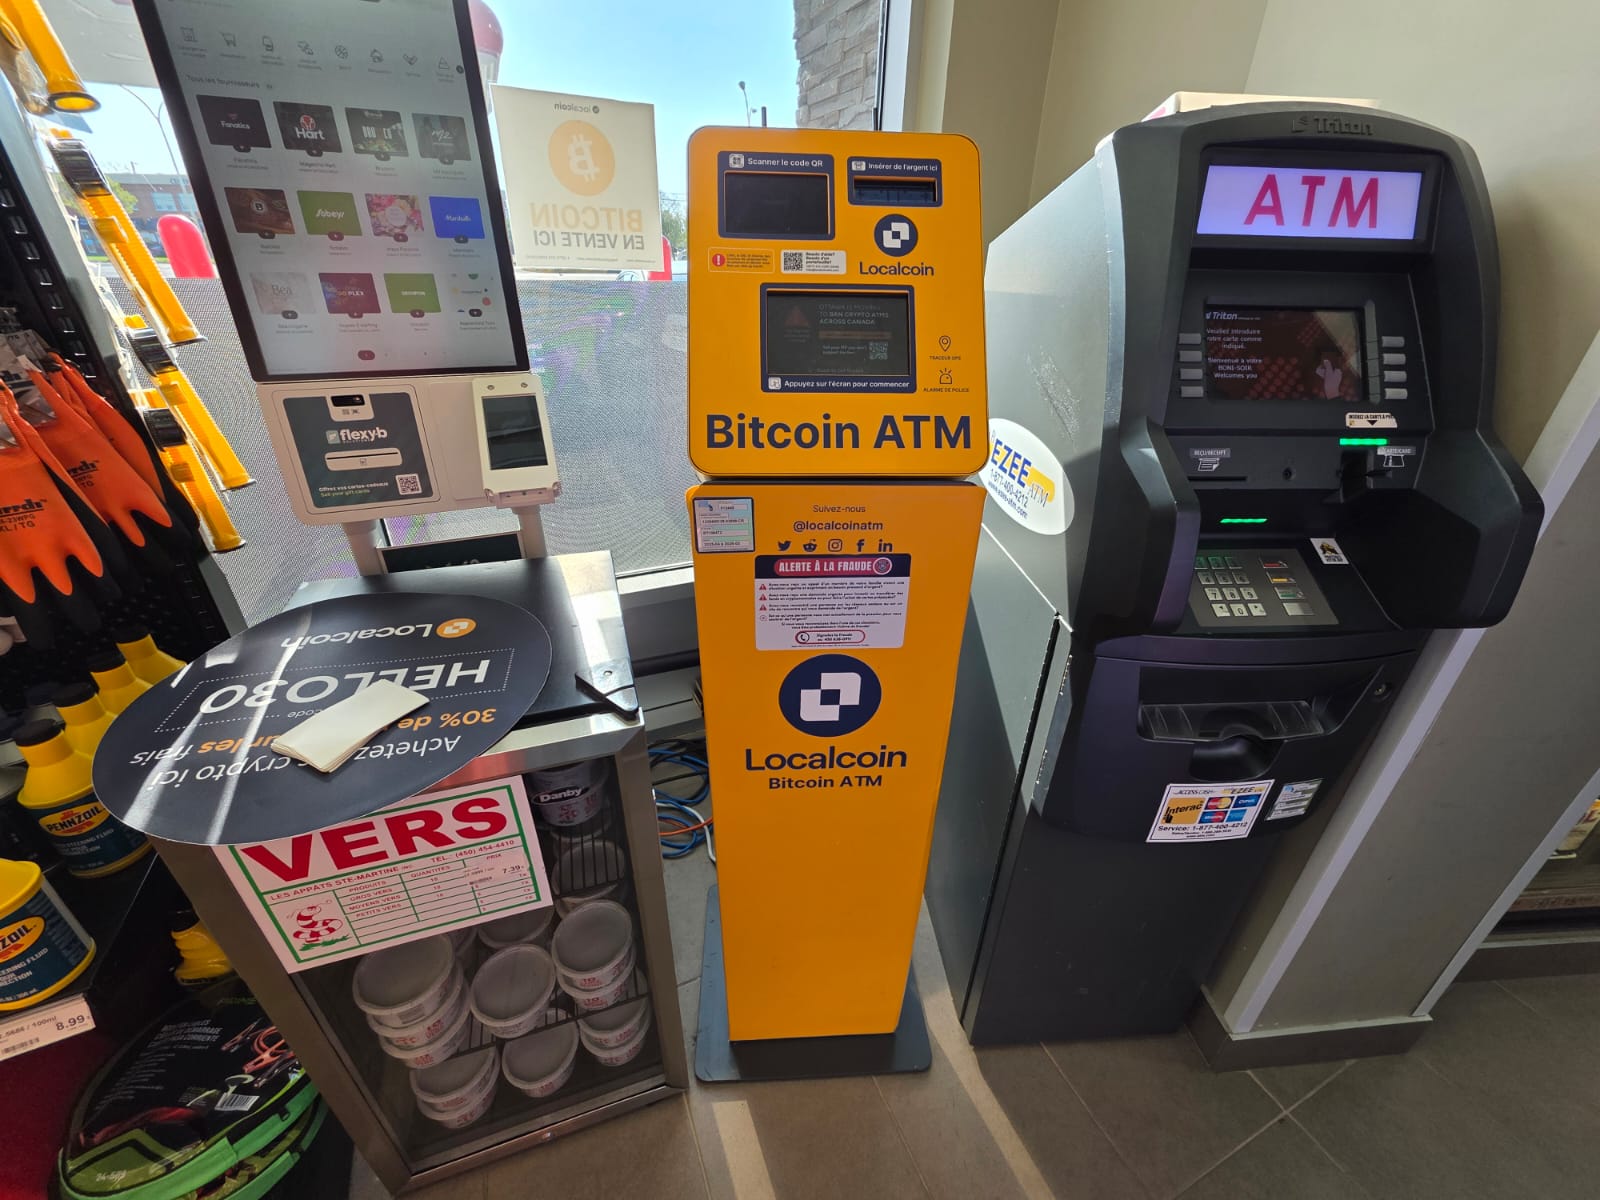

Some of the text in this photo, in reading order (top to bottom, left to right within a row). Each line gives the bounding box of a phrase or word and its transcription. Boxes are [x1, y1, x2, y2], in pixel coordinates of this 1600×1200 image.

[296, 126, 325, 140] Hart
[1314, 117, 1374, 136] Triton
[748, 158, 824, 168] Scanner le code QR
[894, 162, 902, 170] de
[1244, 174, 1379, 228] ATM
[860, 260, 934, 276] Localcoin
[1212, 312, 1238, 320] Triton
[784, 380, 814, 389] Appuyez
[828, 380, 851, 388] l'écran
[852, 381, 868, 389] pour
[870, 380, 910, 388] commencer
[706, 413, 971, 449] Bitcoin ATM
[990, 438, 1032, 488] EZEE
[1029, 483, 1049, 508] ATM
[813, 504, 866, 513] Suivez-nous
[18, 520, 36, 528] TG
[793, 520, 883, 533] @localcoinatm
[779, 559, 872, 572] ALERTE À LA FRAUDE
[280, 623, 433, 650] Localcoin
[200, 660, 490, 714] HELLO30
[129, 708, 496, 766] 30% de ur les frais
[148, 735, 460, 791] Achetez crypto ici
[745, 745, 907, 770] Localcoin
[768, 775, 882, 790] Bitcoin ATM
[540, 788, 582, 802] Danby
[1164, 804, 1202, 816] Interac
[46, 806, 102, 832] PENNZOIL
[1192, 822, 1248, 830] 1-877-400-4212
[240, 798, 508, 882] VERS
[270, 892, 290, 900] LES
[456, 850, 476, 858] (450)
[478, 840, 514, 852] 454-4410
[503, 864, 520, 874] 7.39
[348, 880, 387, 892] PRODUITS
[348, 900, 380, 911] MOYENS
[382, 894, 400, 903] VERS
[350, 888, 392, 902] GROS VERS
[356, 906, 382, 918] PETITS
[382, 903, 402, 912] VERS
[26, 948, 48, 964] FLUID
[32, 1016, 58, 1028] 100ml
[56, 1014, 85, 1032] 8.99
